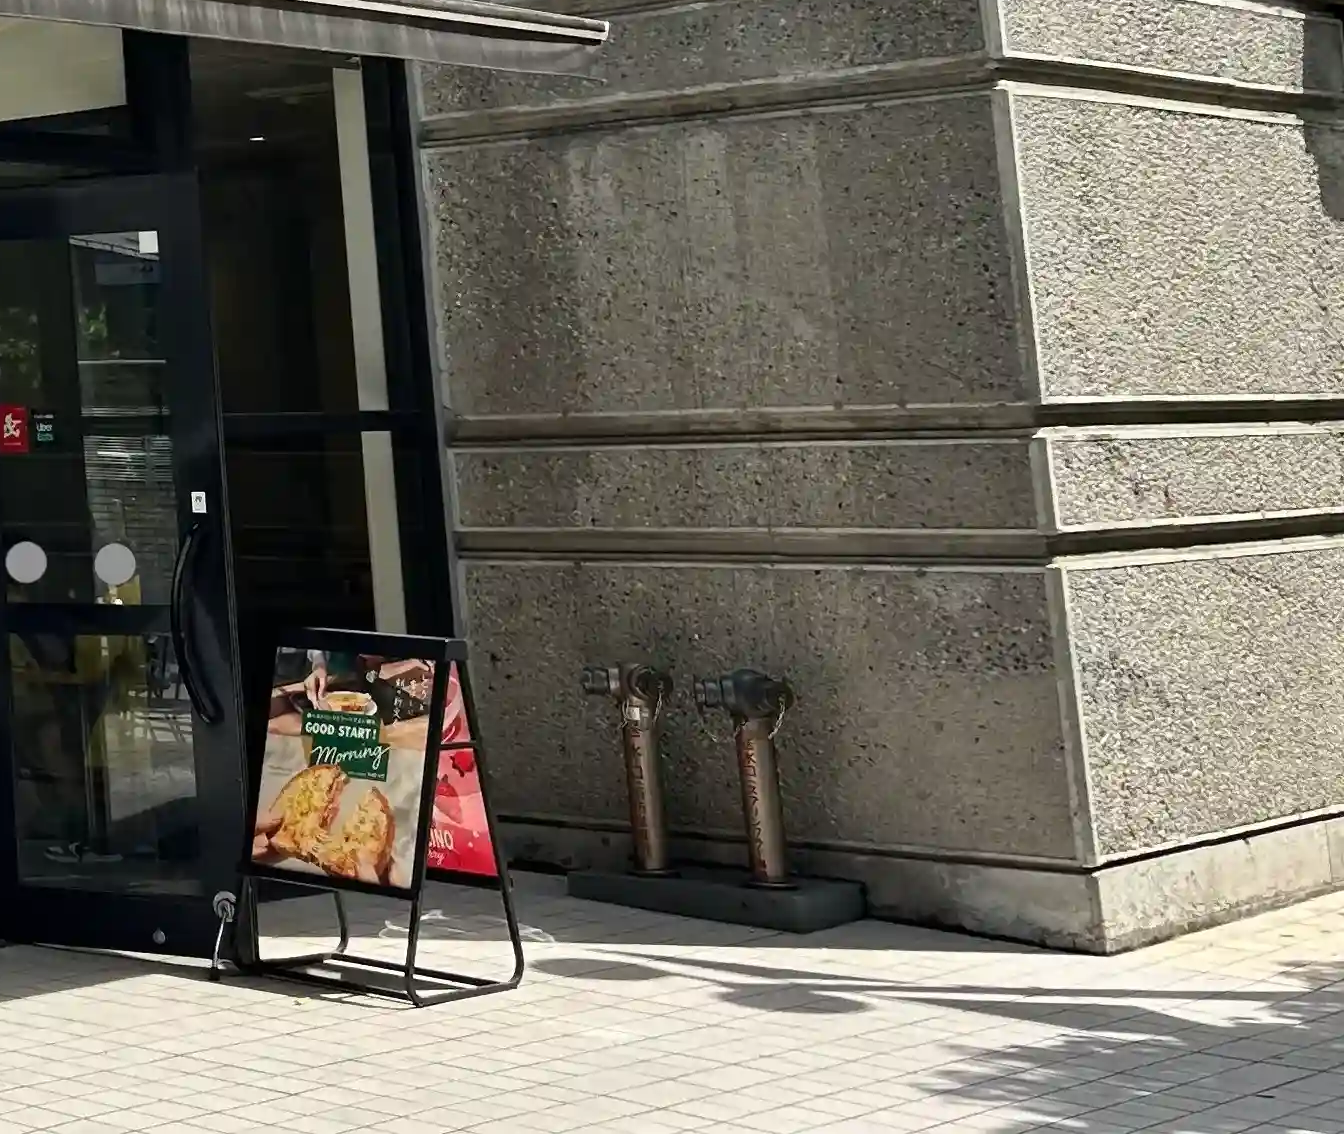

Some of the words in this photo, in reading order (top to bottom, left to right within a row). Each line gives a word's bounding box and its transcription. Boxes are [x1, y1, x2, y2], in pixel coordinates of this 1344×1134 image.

[305, 721, 335, 735] GOOD
[337, 725, 378, 741] START!
[310, 742, 393, 770] Morning
